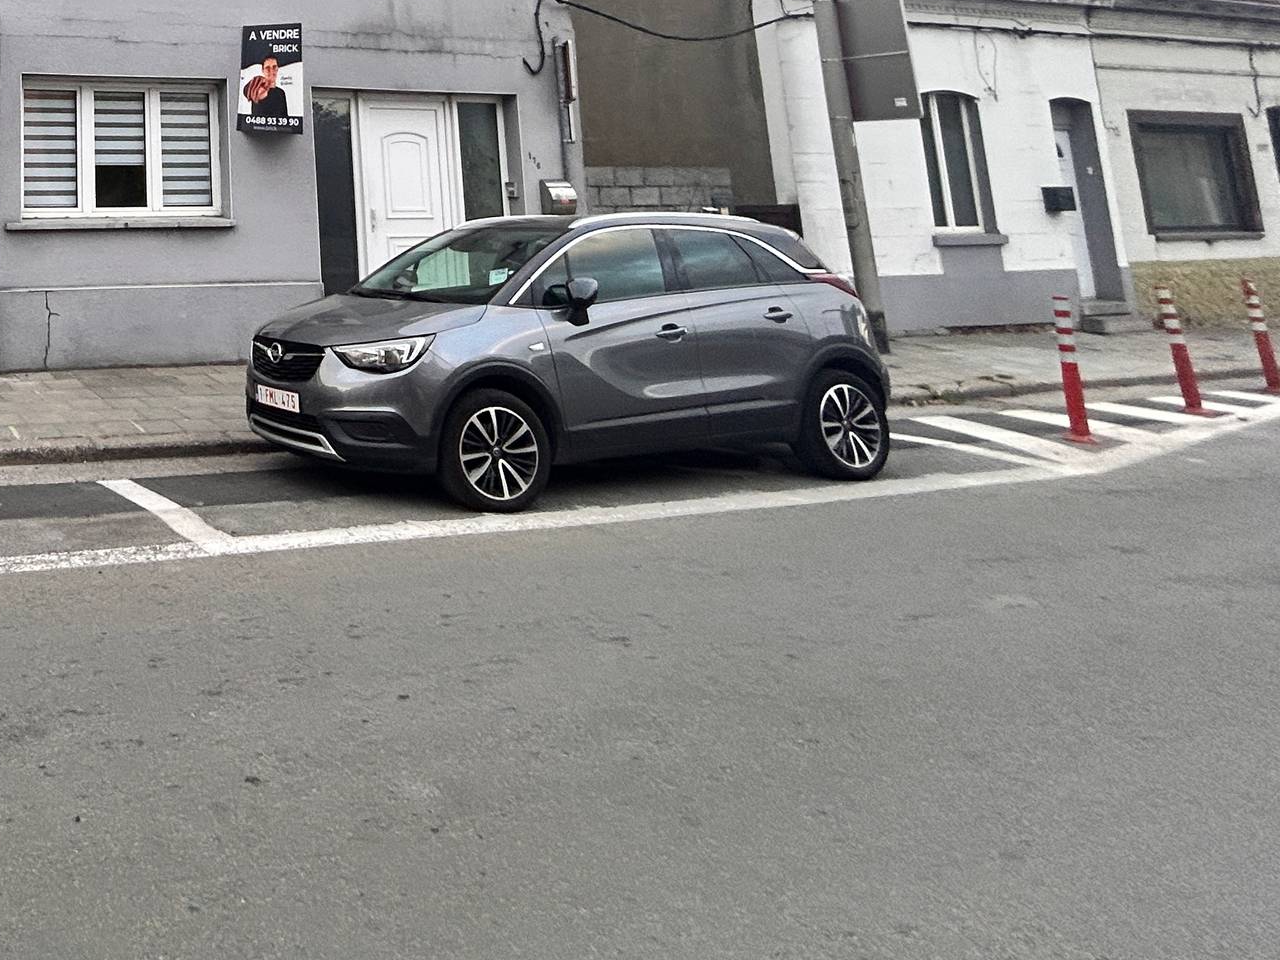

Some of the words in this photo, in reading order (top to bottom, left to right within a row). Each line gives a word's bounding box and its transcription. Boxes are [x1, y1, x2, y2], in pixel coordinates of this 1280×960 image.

[249, 31, 257, 40] A
[260, 29, 300, 40] VENDRE
[272, 44, 299, 53] BRICK
[245, 116, 266, 125] 0488
[267, 116, 277, 125] 93
[278, 117, 288, 126] 39
[289, 118, 300, 127] 90
